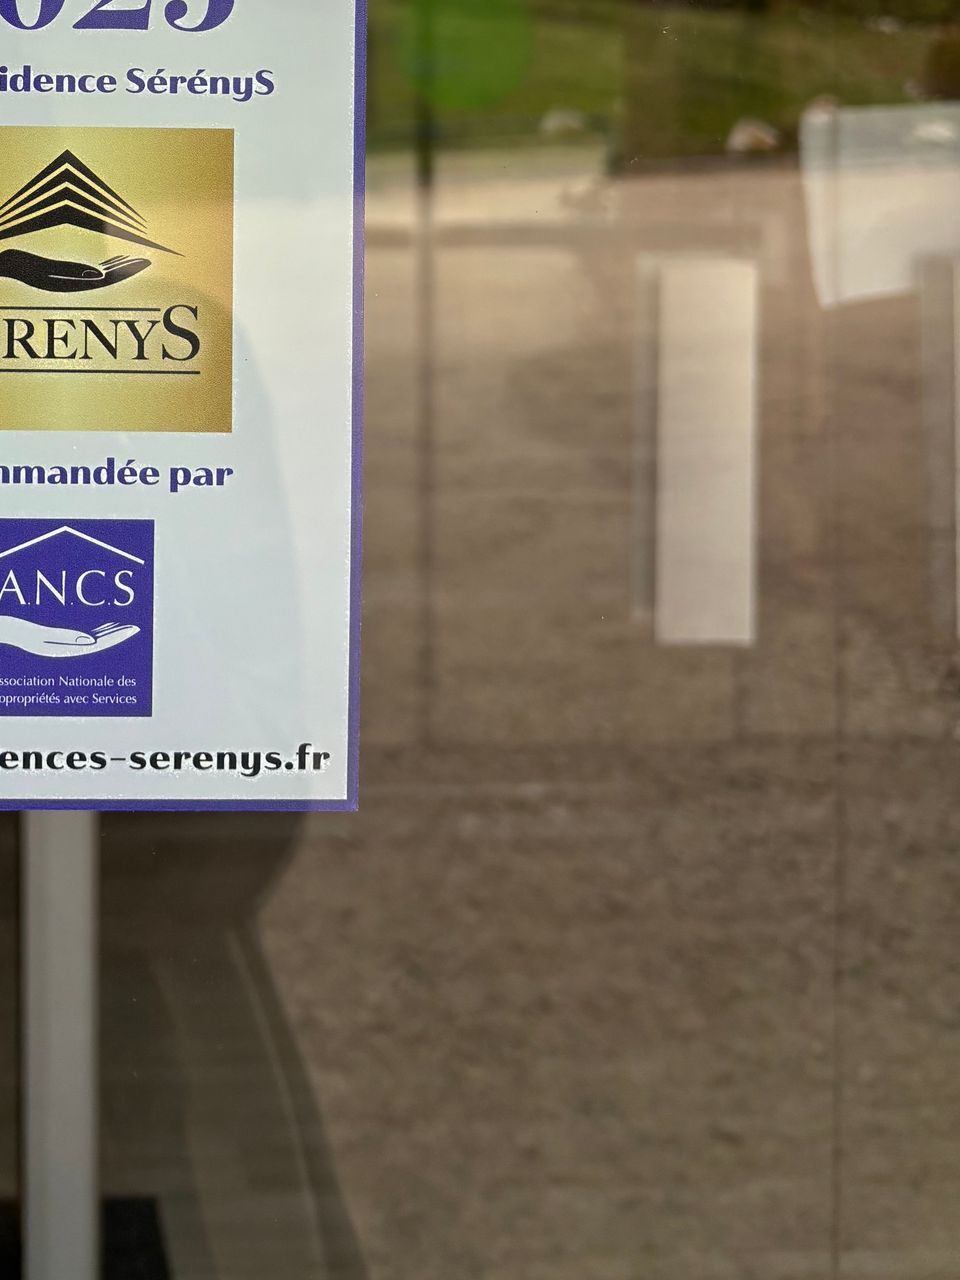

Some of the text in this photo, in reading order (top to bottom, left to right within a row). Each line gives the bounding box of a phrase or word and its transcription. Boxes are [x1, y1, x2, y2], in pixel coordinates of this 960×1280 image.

[126, 69, 275, 102] SérényS
[170, 467, 234, 492] par
[59, 676, 114, 686] Nationale
[117, 676, 136, 687] des
[64, 696, 89, 704] avec
[92, 693, 137, 704] Services
